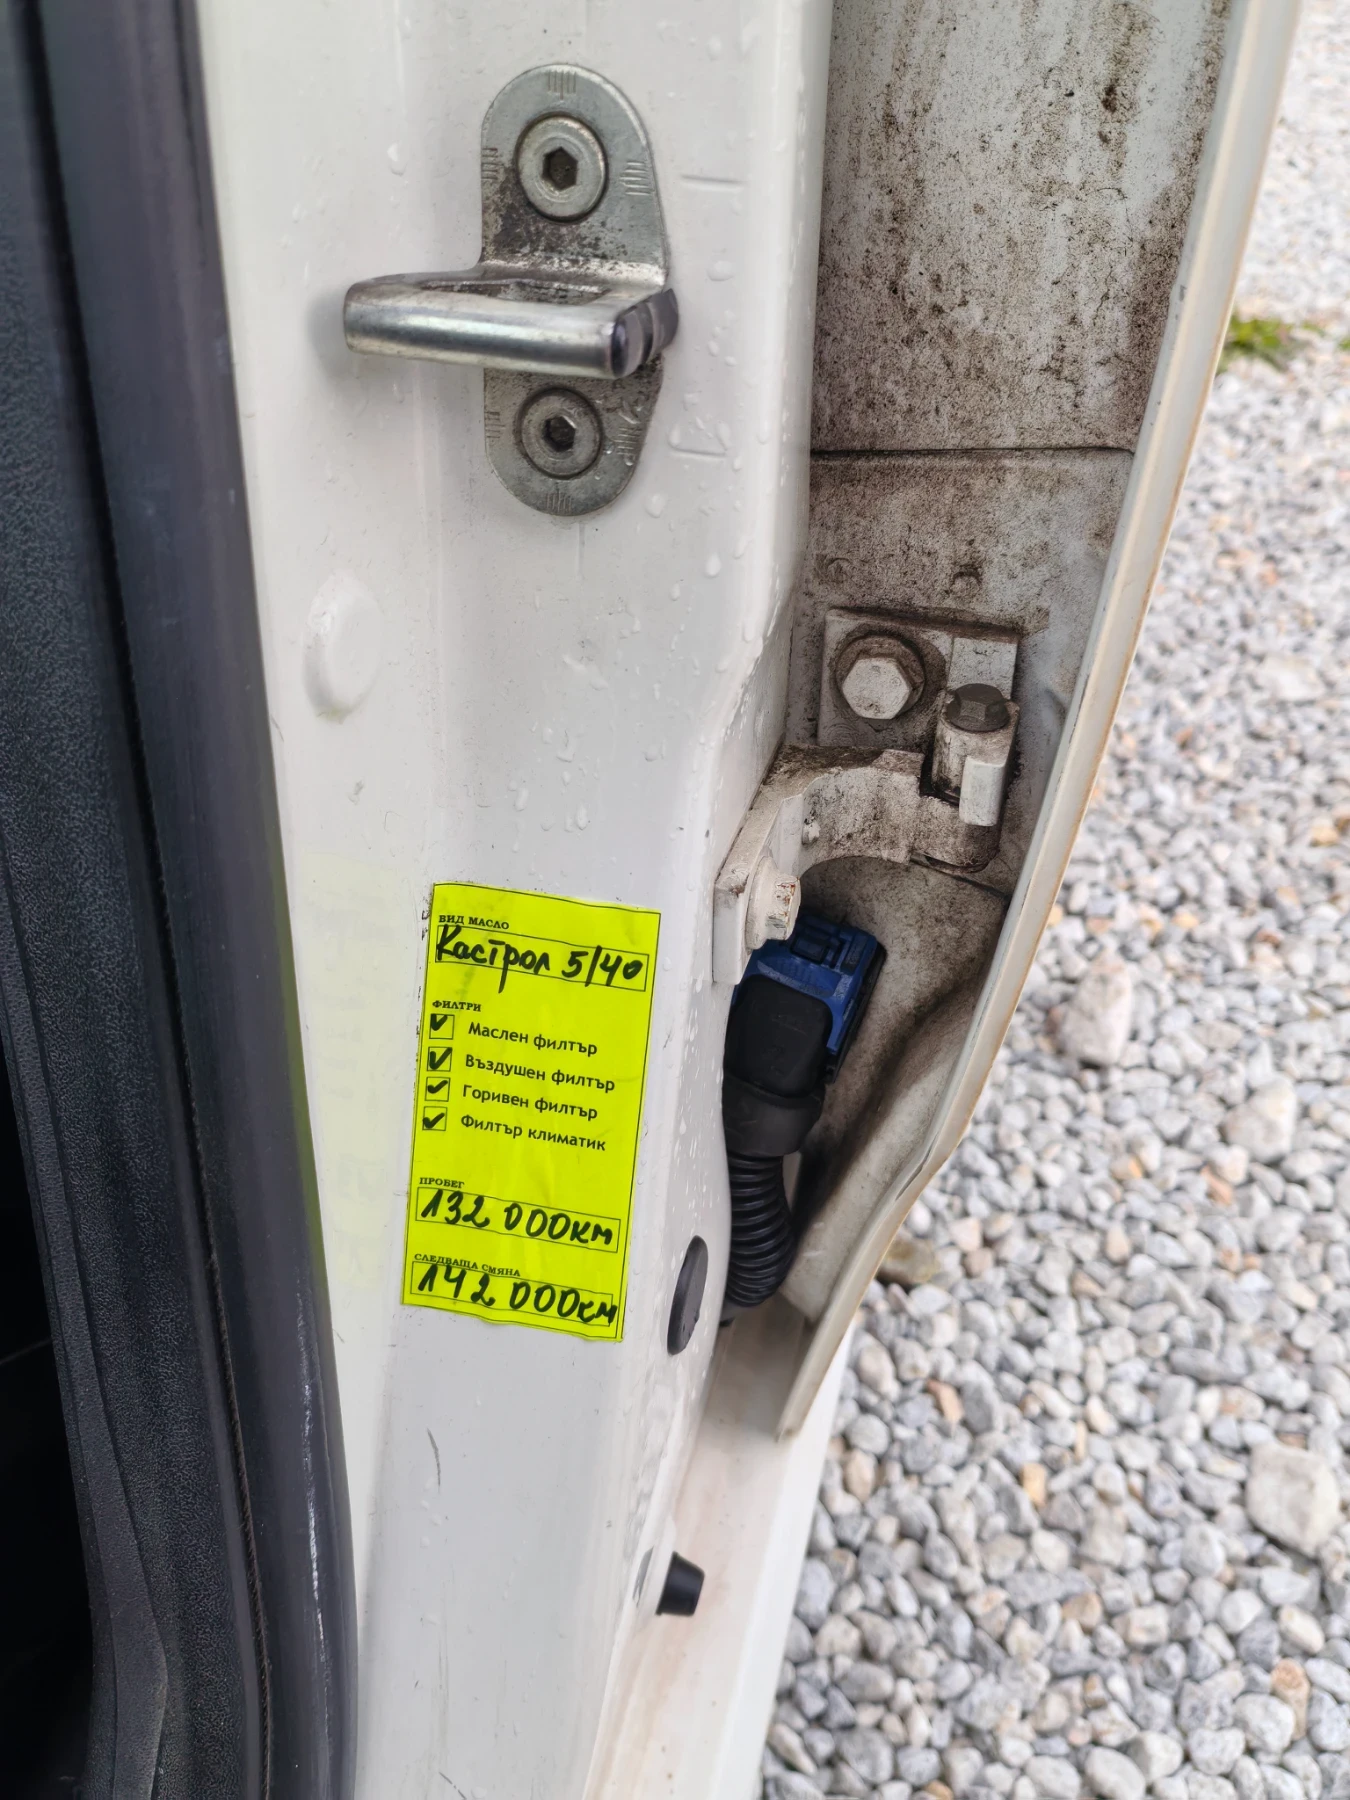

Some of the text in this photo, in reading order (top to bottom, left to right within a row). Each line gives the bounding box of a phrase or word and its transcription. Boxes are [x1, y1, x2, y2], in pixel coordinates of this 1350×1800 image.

[438, 915, 510, 930] ВИД МАСЛО
[436, 924, 643, 994] Кастрол 5/40
[432, 1000, 482, 1012] ФИЛТРИ
[468, 1022, 598, 1057] Маслен филтър
[465, 1054, 615, 1093] Въздушен филтър
[463, 1084, 598, 1121] Горивен филтър
[460, 1114, 606, 1151] Филтър климатик
[419, 1177, 465, 1189] ПРОБЕГ
[420, 1189, 490, 1228] 132
[414, 1253, 521, 1277] СЛЕДВАЩА СМЯНА
[417, 1264, 496, 1307] 142
